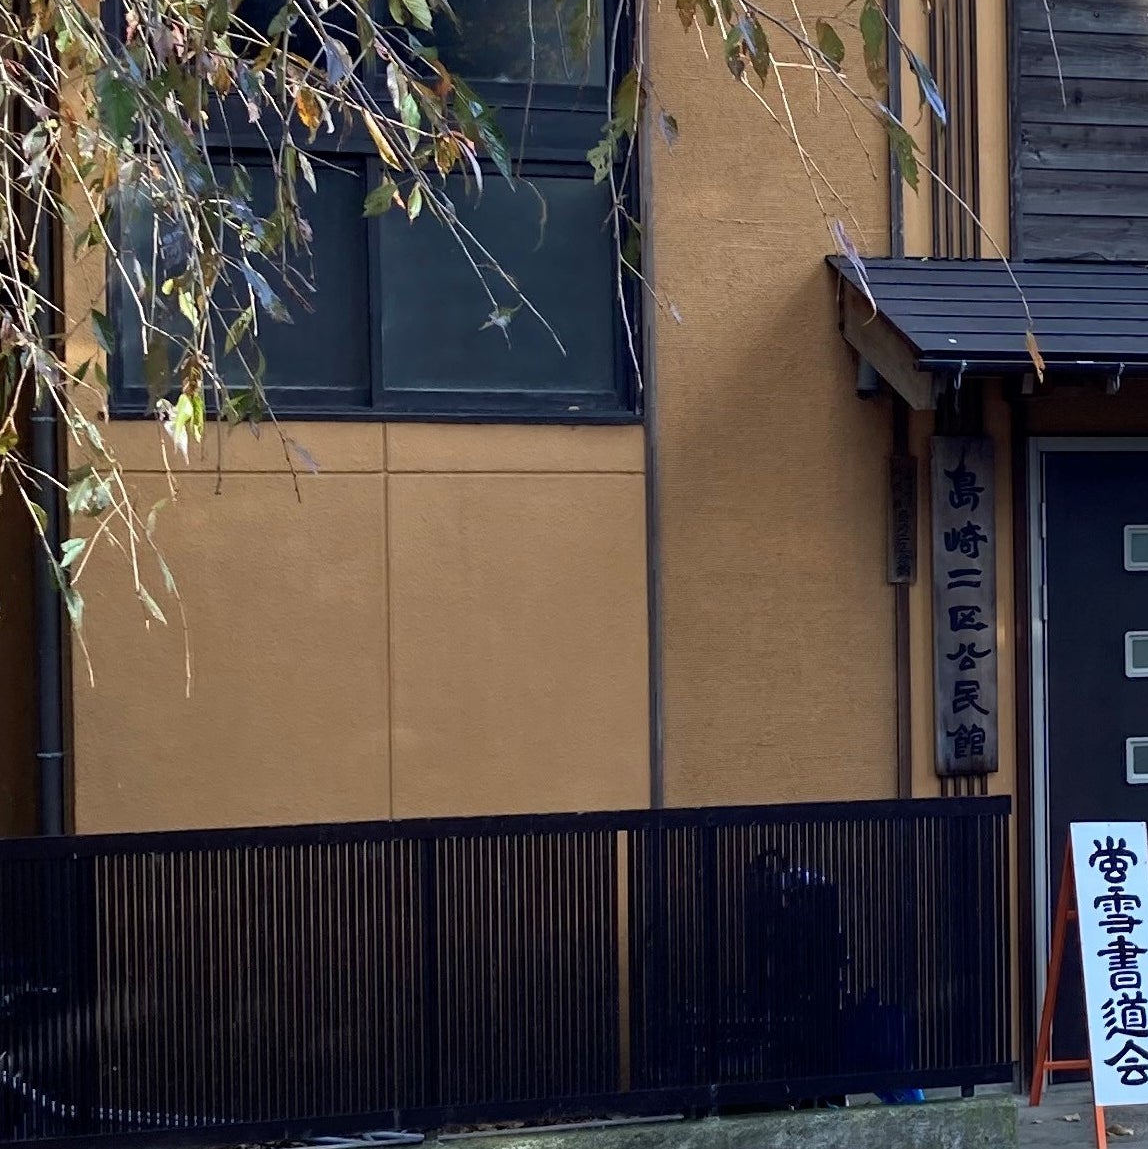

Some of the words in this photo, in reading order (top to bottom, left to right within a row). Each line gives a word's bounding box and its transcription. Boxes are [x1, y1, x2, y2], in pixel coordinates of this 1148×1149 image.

[944, 450, 992, 759] 島崎二区公民館
